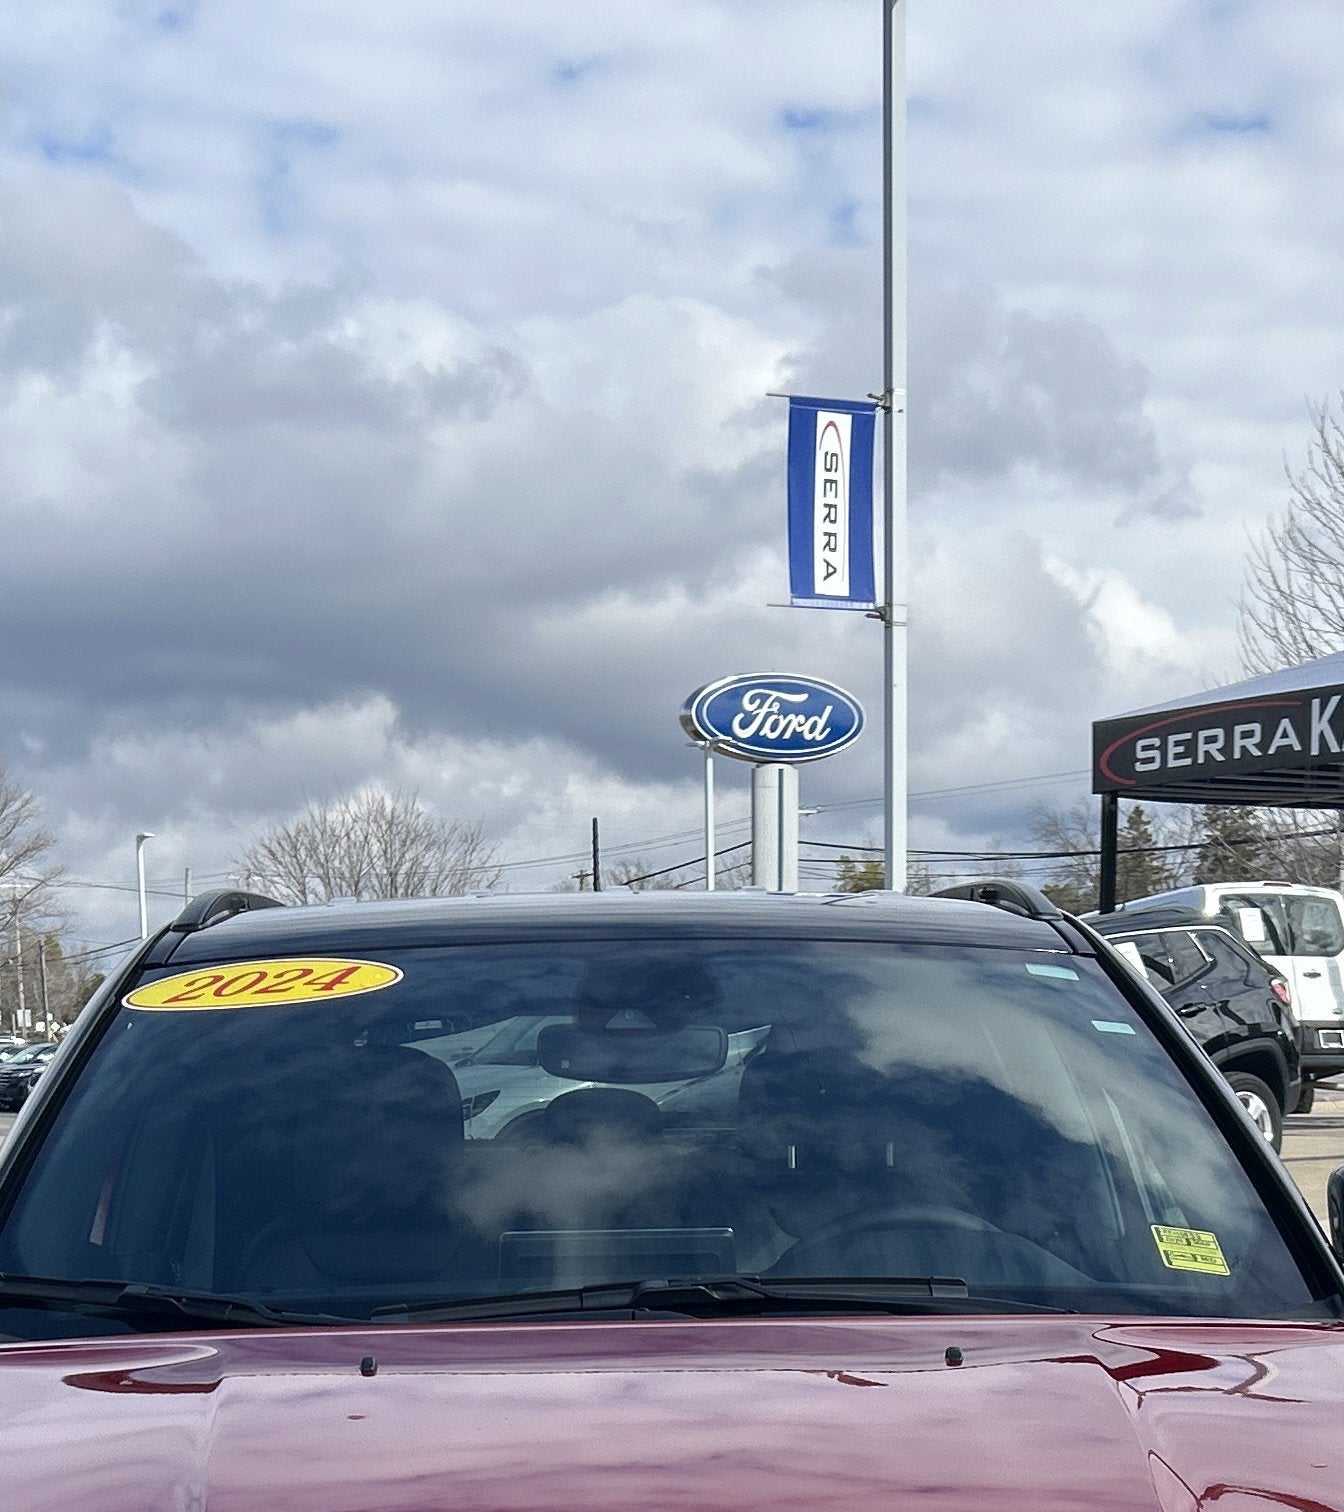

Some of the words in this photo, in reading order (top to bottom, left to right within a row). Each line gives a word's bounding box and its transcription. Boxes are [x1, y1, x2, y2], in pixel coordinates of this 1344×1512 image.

[822, 450, 839, 582] SERRA
[731, 688, 834, 741] Ford
[1133, 717, 1303, 773] SERRA
[160, 965, 362, 1004] 2024
